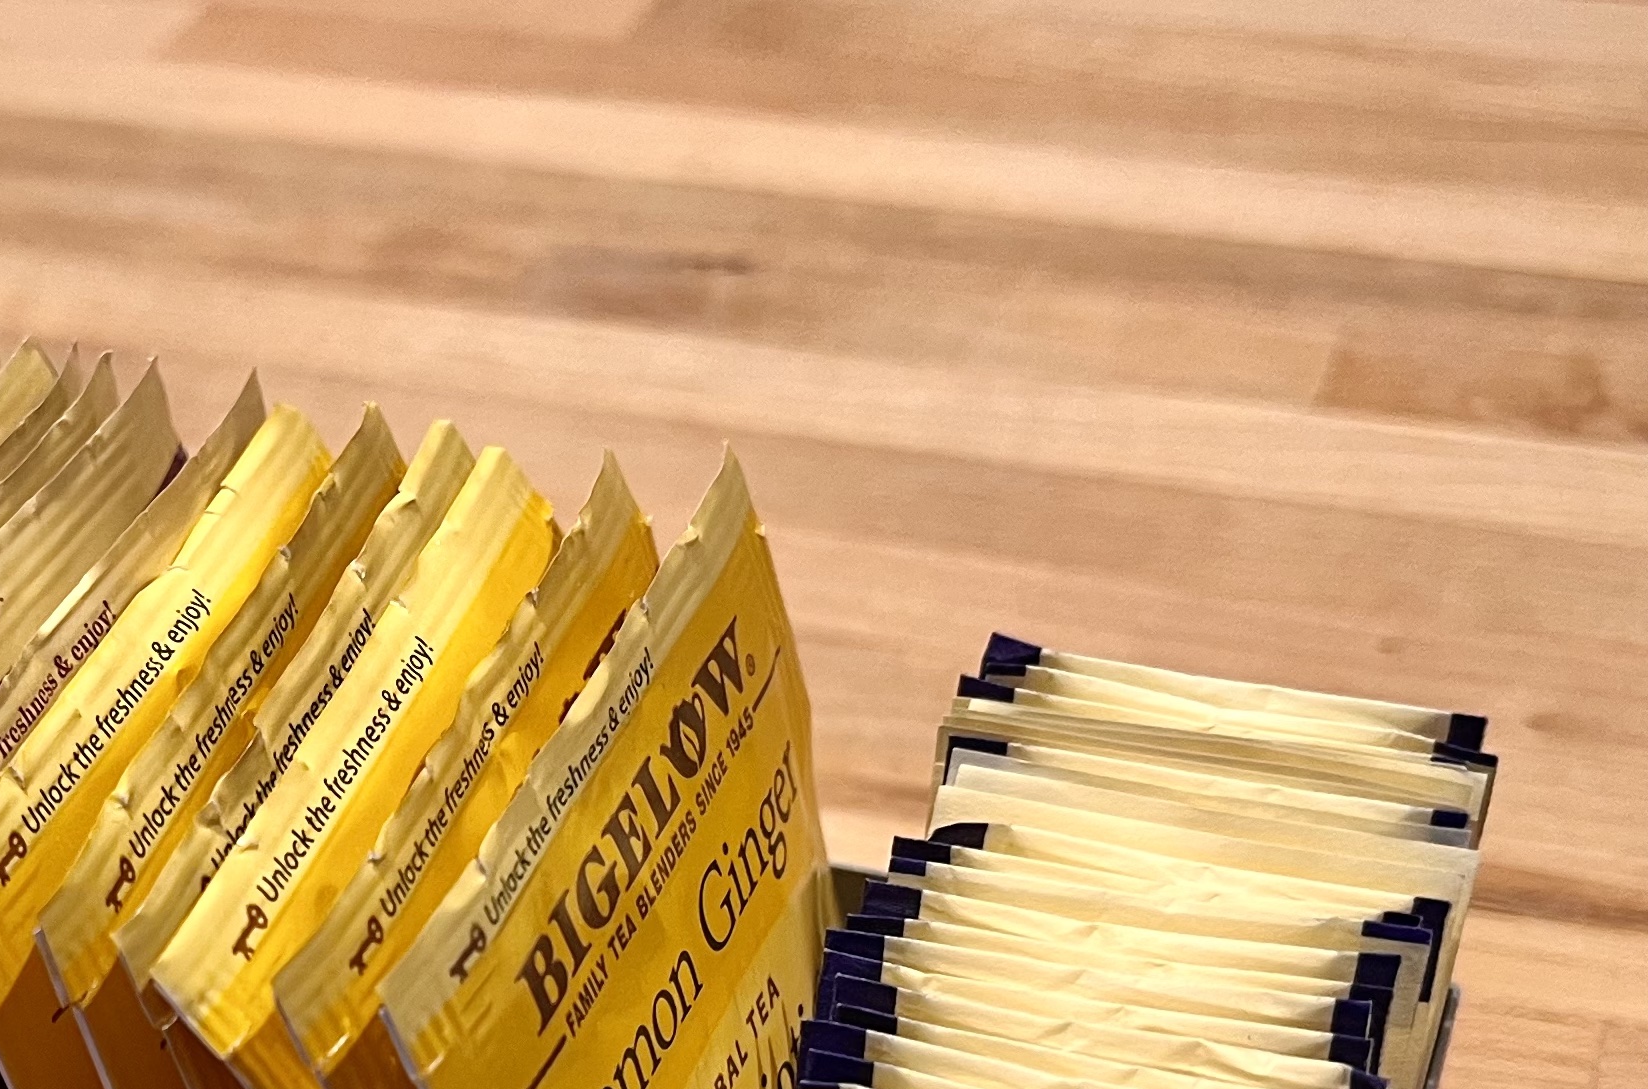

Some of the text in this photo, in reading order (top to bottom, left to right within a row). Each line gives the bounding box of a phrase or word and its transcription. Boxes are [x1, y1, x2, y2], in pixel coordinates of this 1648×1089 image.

[21, 588, 212, 834] Unlock the freshness & enjoy!
[53, 655, 74, 679] &
[71, 600, 117, 661] enjoy!
[129, 592, 299, 859] Unlock the freshness & enjoy!
[273, 683, 333, 776] freshness
[329, 664, 344, 689] &
[256, 636, 434, 903] Unlock the freshness & enjoy!
[380, 640, 545, 918] Unlock the freshness & enjoy!
[483, 646, 654, 926] Unlock the freshness & enjoy!
[565, 706, 754, 1039] FAMILY TEA BLENDERS SINCE 1945
[698, 739, 800, 952] Ginger
[745, 973, 780, 1039] TEA
